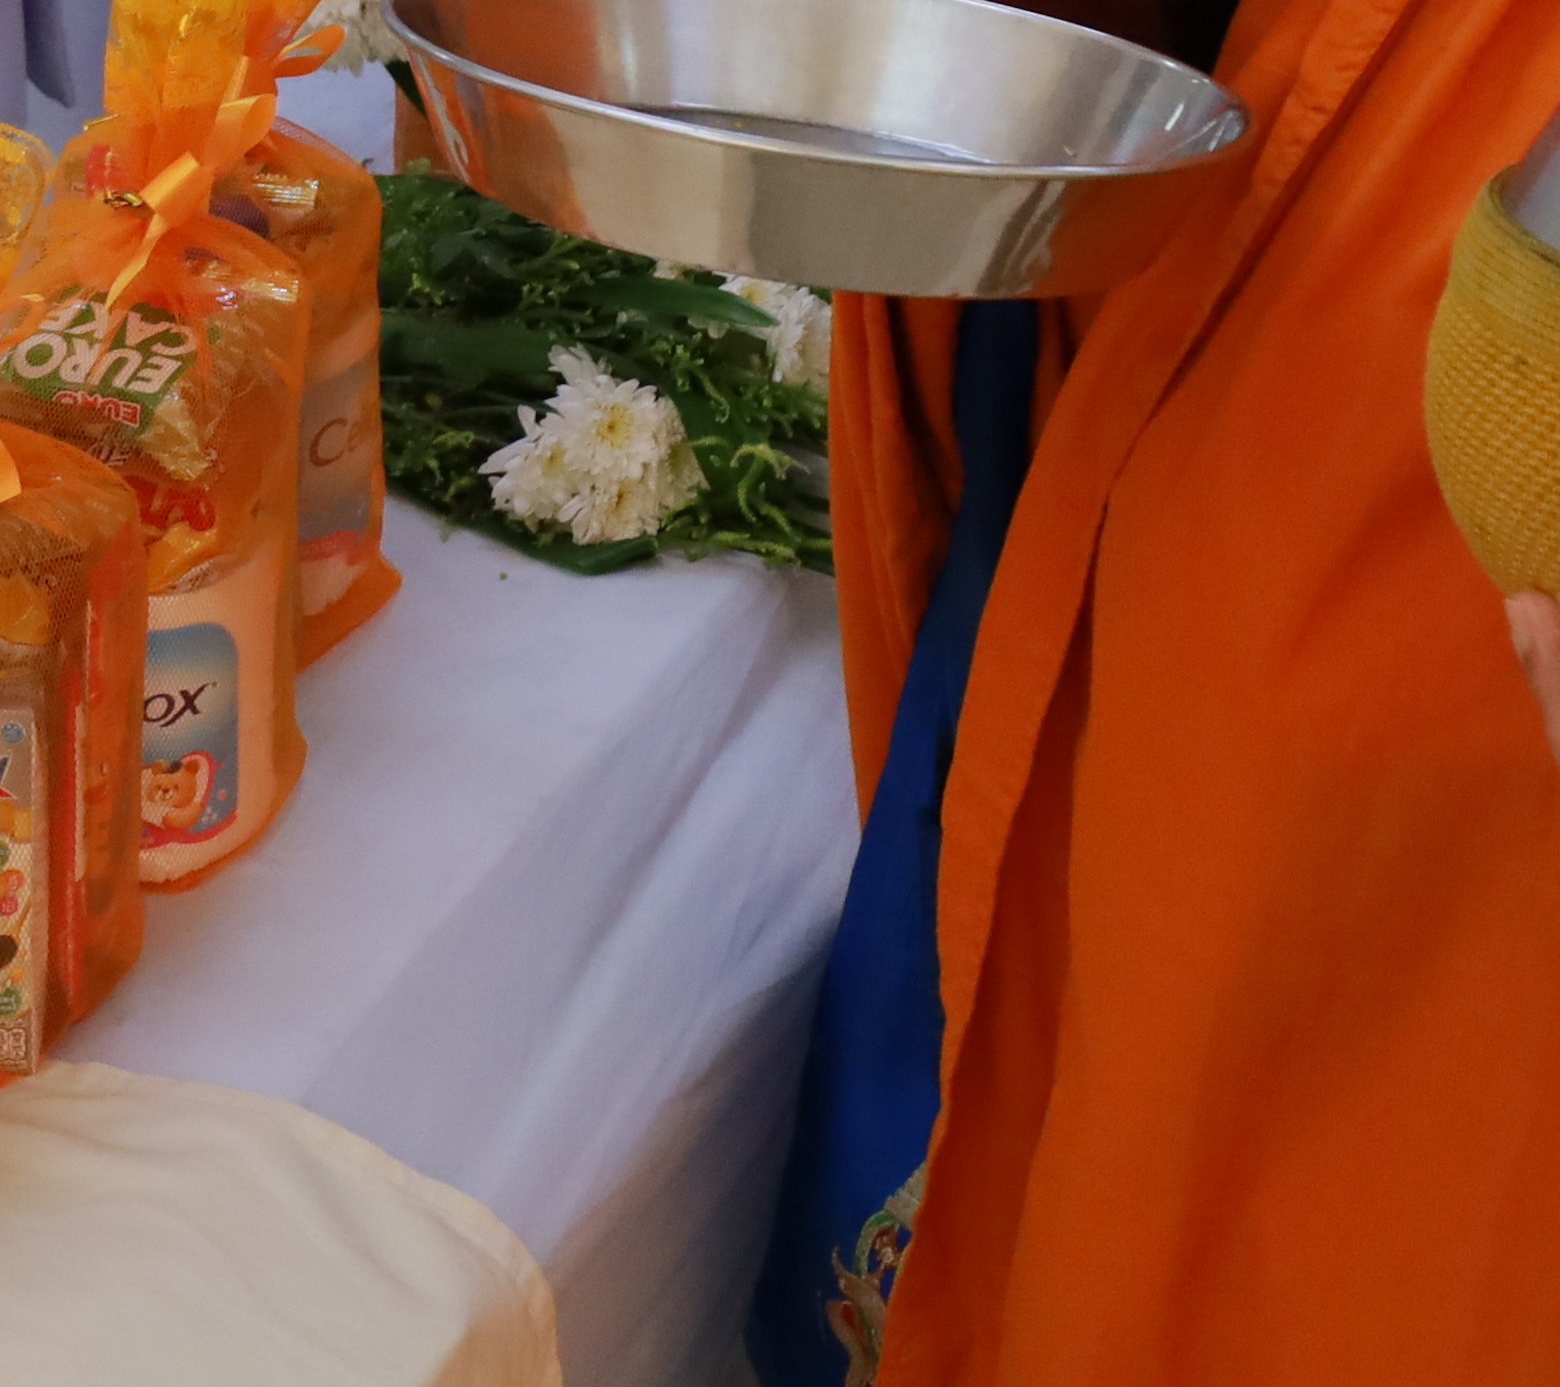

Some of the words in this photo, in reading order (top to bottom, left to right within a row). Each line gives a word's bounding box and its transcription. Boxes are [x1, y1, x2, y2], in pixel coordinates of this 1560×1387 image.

[36, 299, 200, 357] CAKE
[8, 332, 184, 395] EURO
[51, 390, 142, 428] EURO
